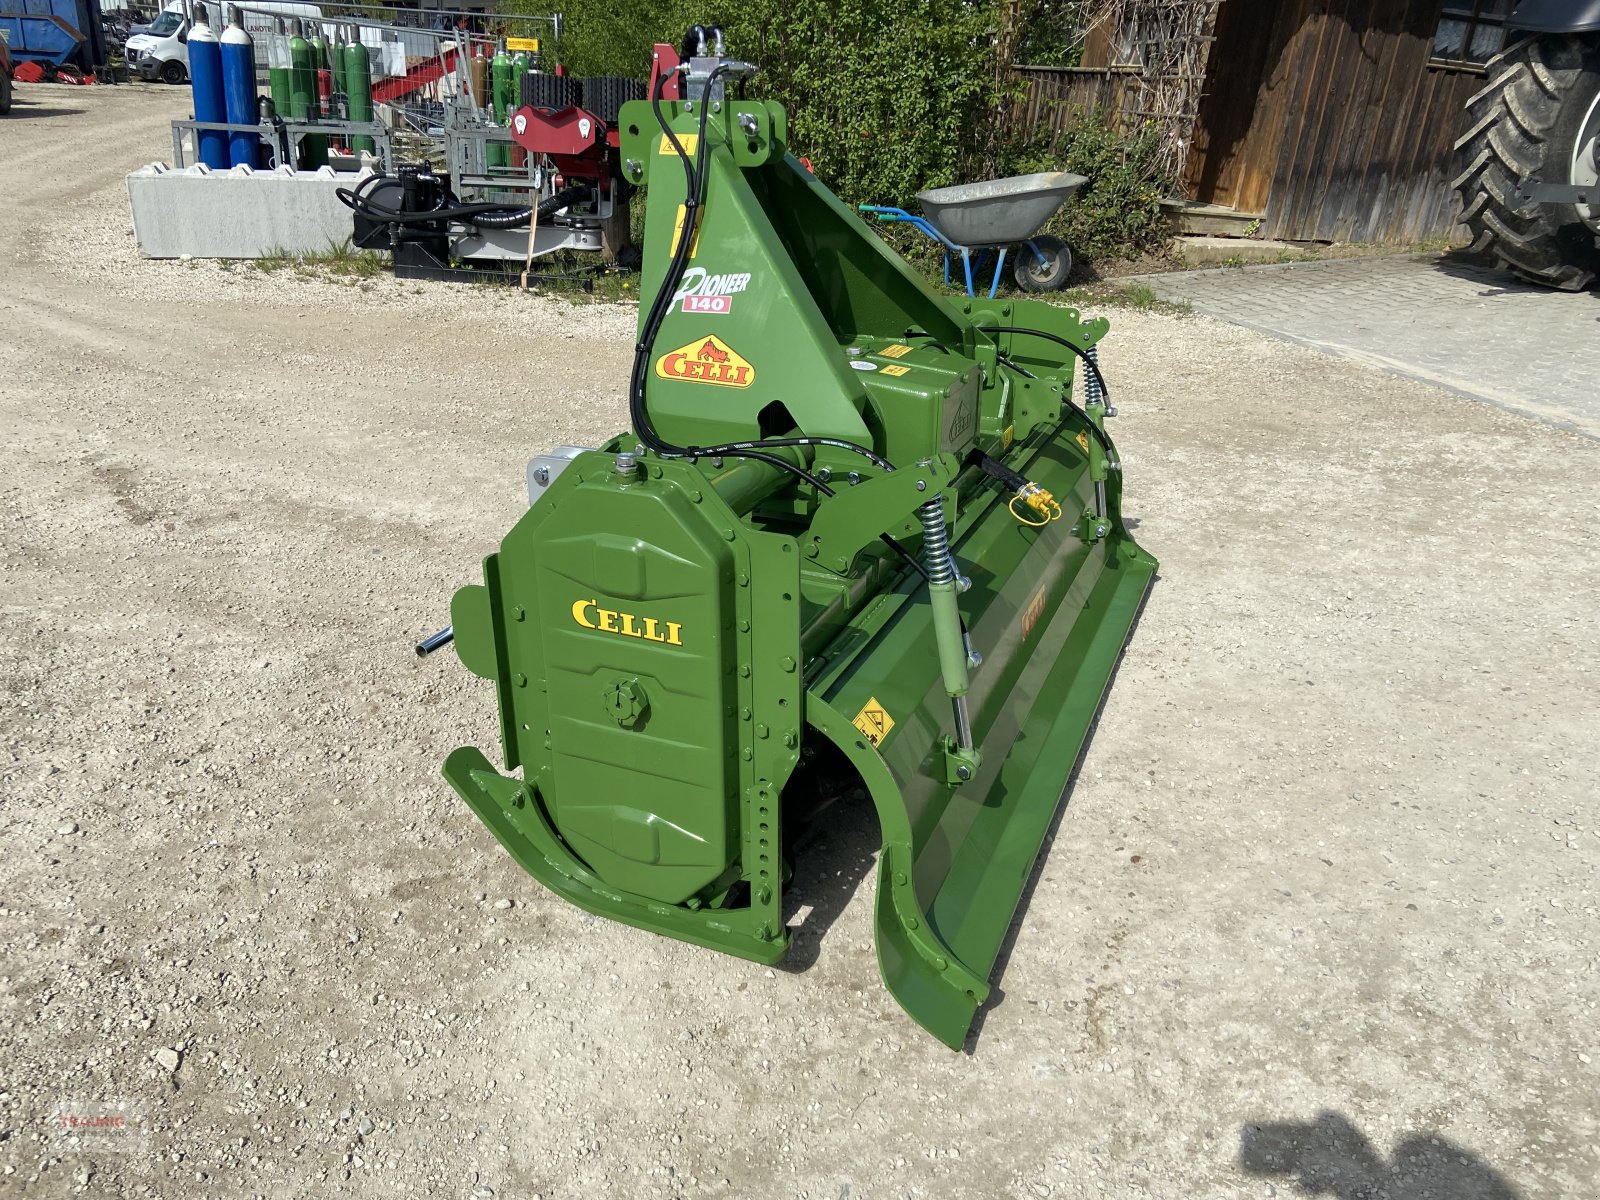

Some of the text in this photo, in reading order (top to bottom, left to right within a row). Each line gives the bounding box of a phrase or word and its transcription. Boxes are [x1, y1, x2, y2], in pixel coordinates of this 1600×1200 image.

[666, 266, 752, 316] PIONEER
[690, 297, 725, 311] 140
[663, 353, 750, 385] CELLI
[571, 599, 683, 646] CELLI
